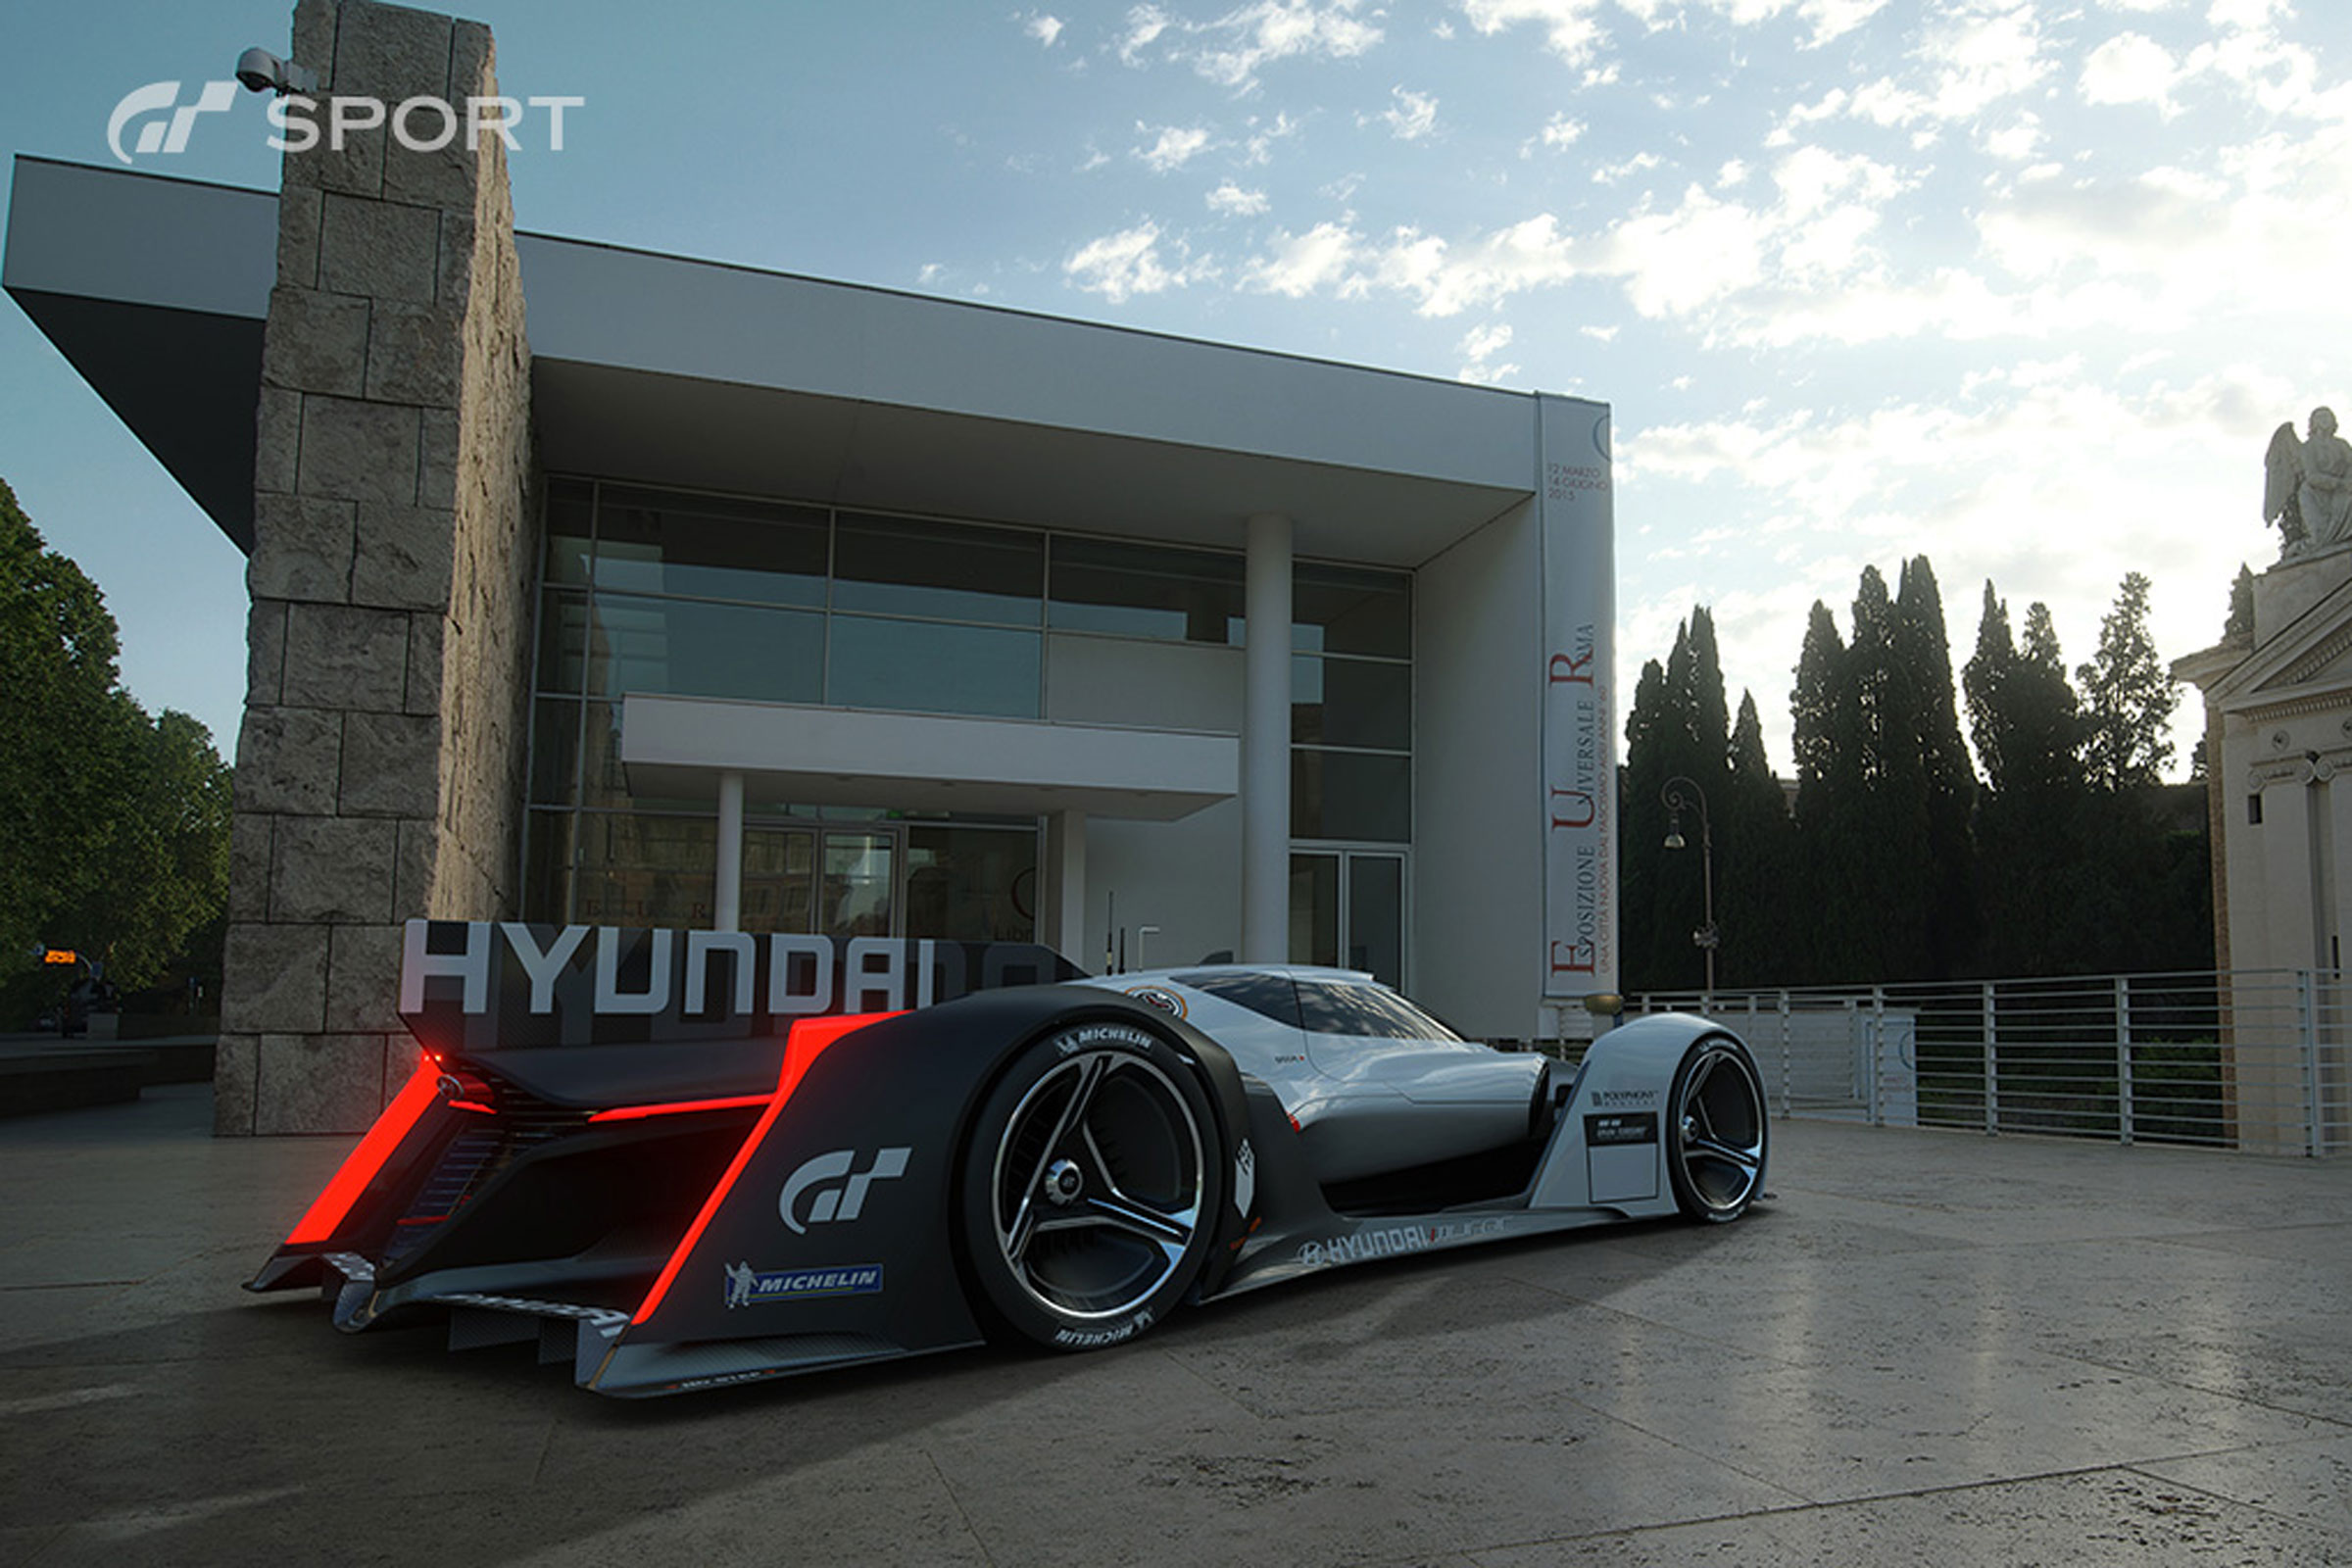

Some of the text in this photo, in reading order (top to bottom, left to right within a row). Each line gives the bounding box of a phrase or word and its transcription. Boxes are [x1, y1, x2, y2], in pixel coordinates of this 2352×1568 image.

[399, 918, 935, 1014] HYUNDAI
[1079, 1027, 1152, 1049] MICHELIN
[1328, 1226, 1428, 1262] HYUNDAI
[759, 1270, 877, 1293] MICHELIN
[1055, 1325, 1134, 1347] MICHELIN
